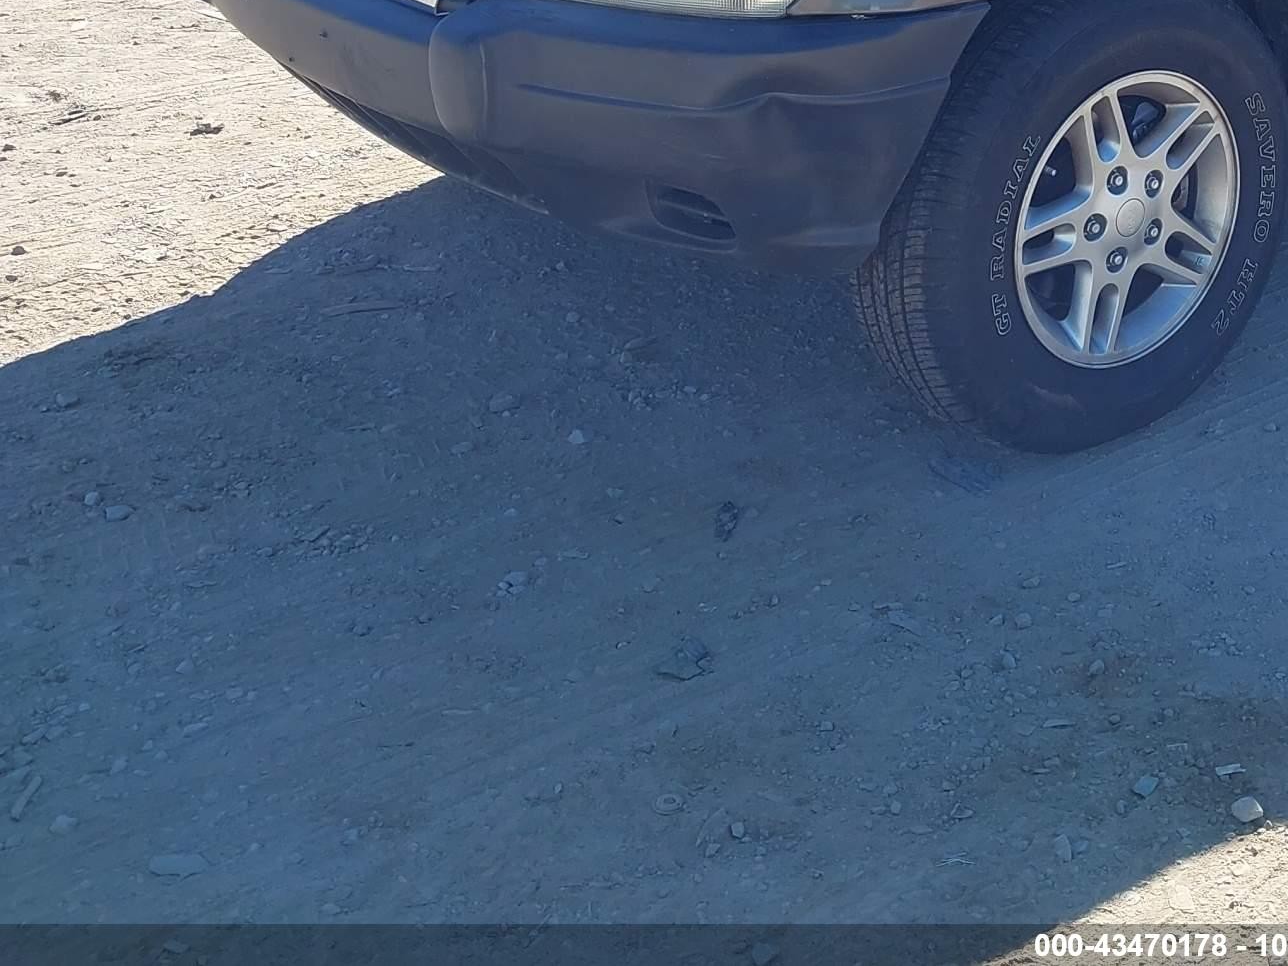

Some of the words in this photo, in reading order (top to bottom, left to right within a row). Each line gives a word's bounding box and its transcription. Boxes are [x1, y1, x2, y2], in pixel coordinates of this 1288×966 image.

[990, 135, 1042, 281] RADIAL
[1244, 92, 1276, 243] SAVERO
[992, 293, 1012, 335] GT
